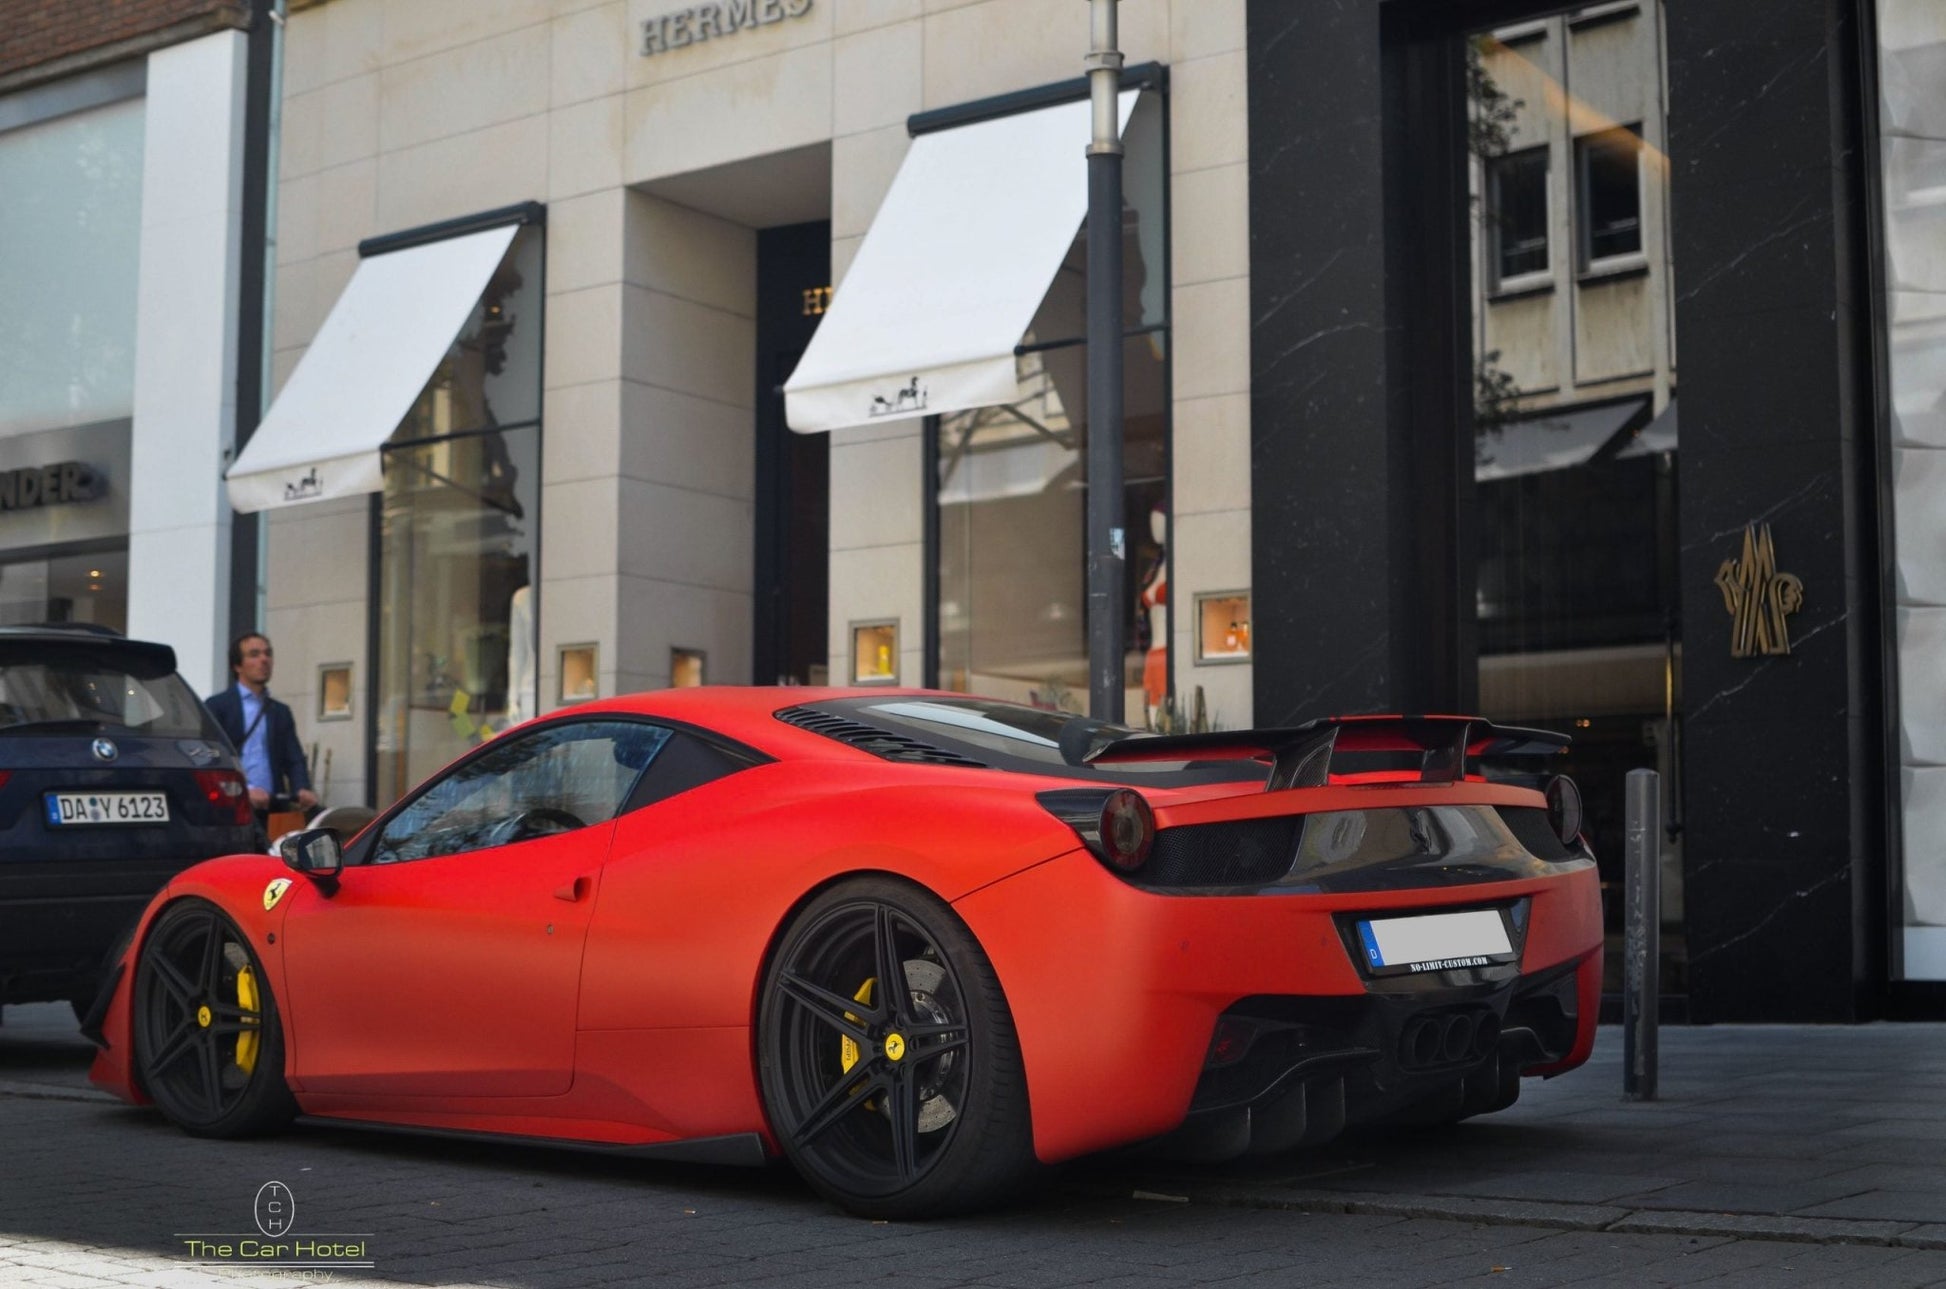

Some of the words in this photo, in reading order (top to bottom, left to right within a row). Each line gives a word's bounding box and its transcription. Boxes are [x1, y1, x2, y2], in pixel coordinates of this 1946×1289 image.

[60, 797, 88, 820] DA
[99, 798, 111, 819] Y
[118, 796, 165, 819] 6123
[1410, 956, 1488, 973] NO-LIMIT-CUSTOM.COM
